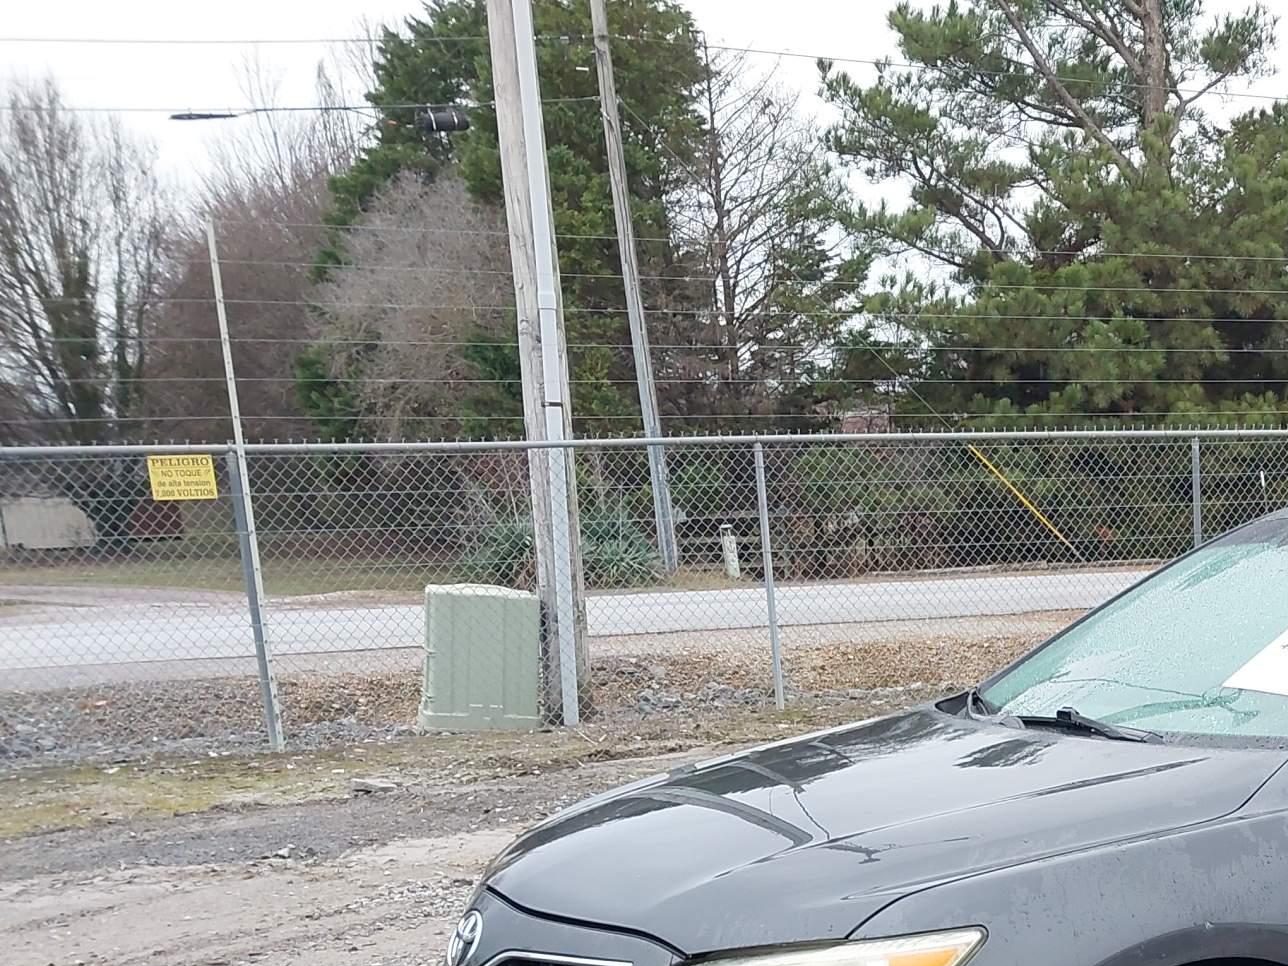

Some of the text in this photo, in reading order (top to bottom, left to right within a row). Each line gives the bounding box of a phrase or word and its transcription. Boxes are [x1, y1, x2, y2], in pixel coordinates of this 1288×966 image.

[151, 457, 209, 467] PELIGRO
[160, 469, 202, 478] NO TOQUE
[157, 480, 166, 488] de
[177, 488, 215, 497] VOLTIOS
